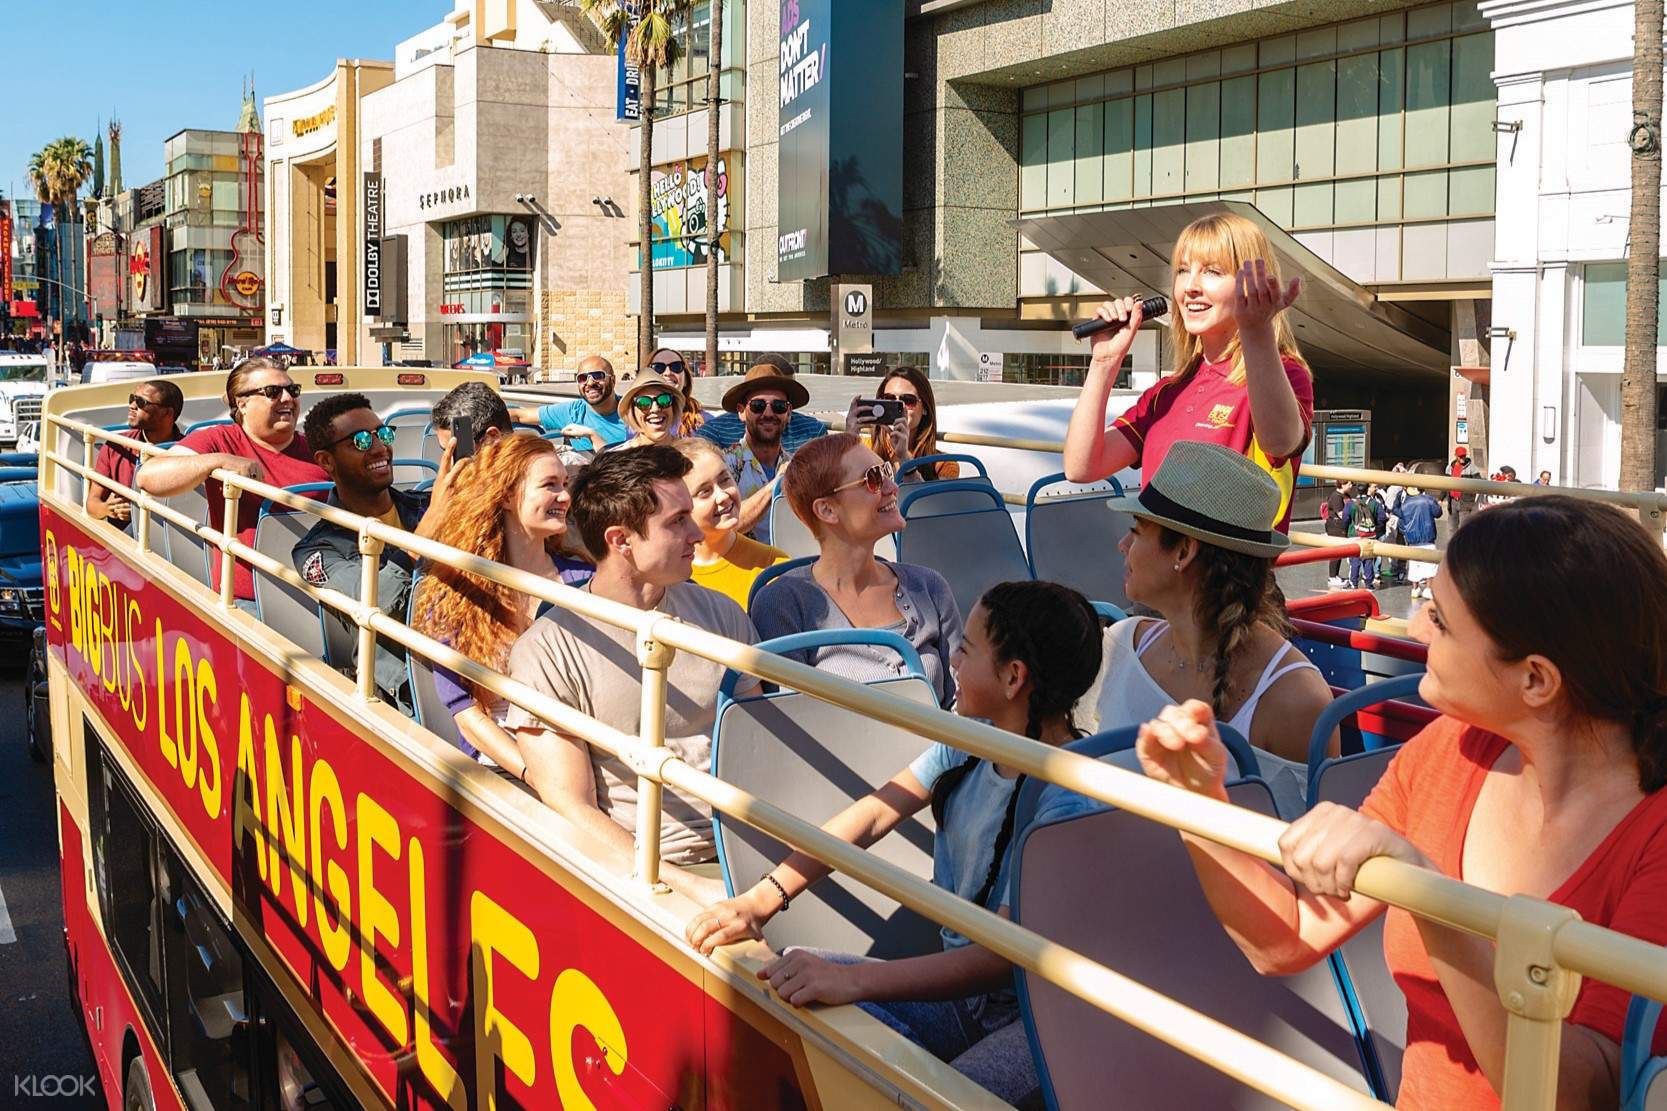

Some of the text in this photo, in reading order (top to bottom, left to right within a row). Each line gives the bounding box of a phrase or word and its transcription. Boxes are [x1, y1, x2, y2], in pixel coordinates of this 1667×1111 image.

[780, 19, 809, 74] DON'T
[625, 98, 639, 118] EAT
[419, 184, 470, 210] SEPHORA
[654, 172, 682, 200] HELLO
[367, 180, 379, 288] DOLBY THEATRE
[847, 294, 864, 313] M
[842, 319, 868, 329] Metro
[156, 616, 222, 820] LOS
